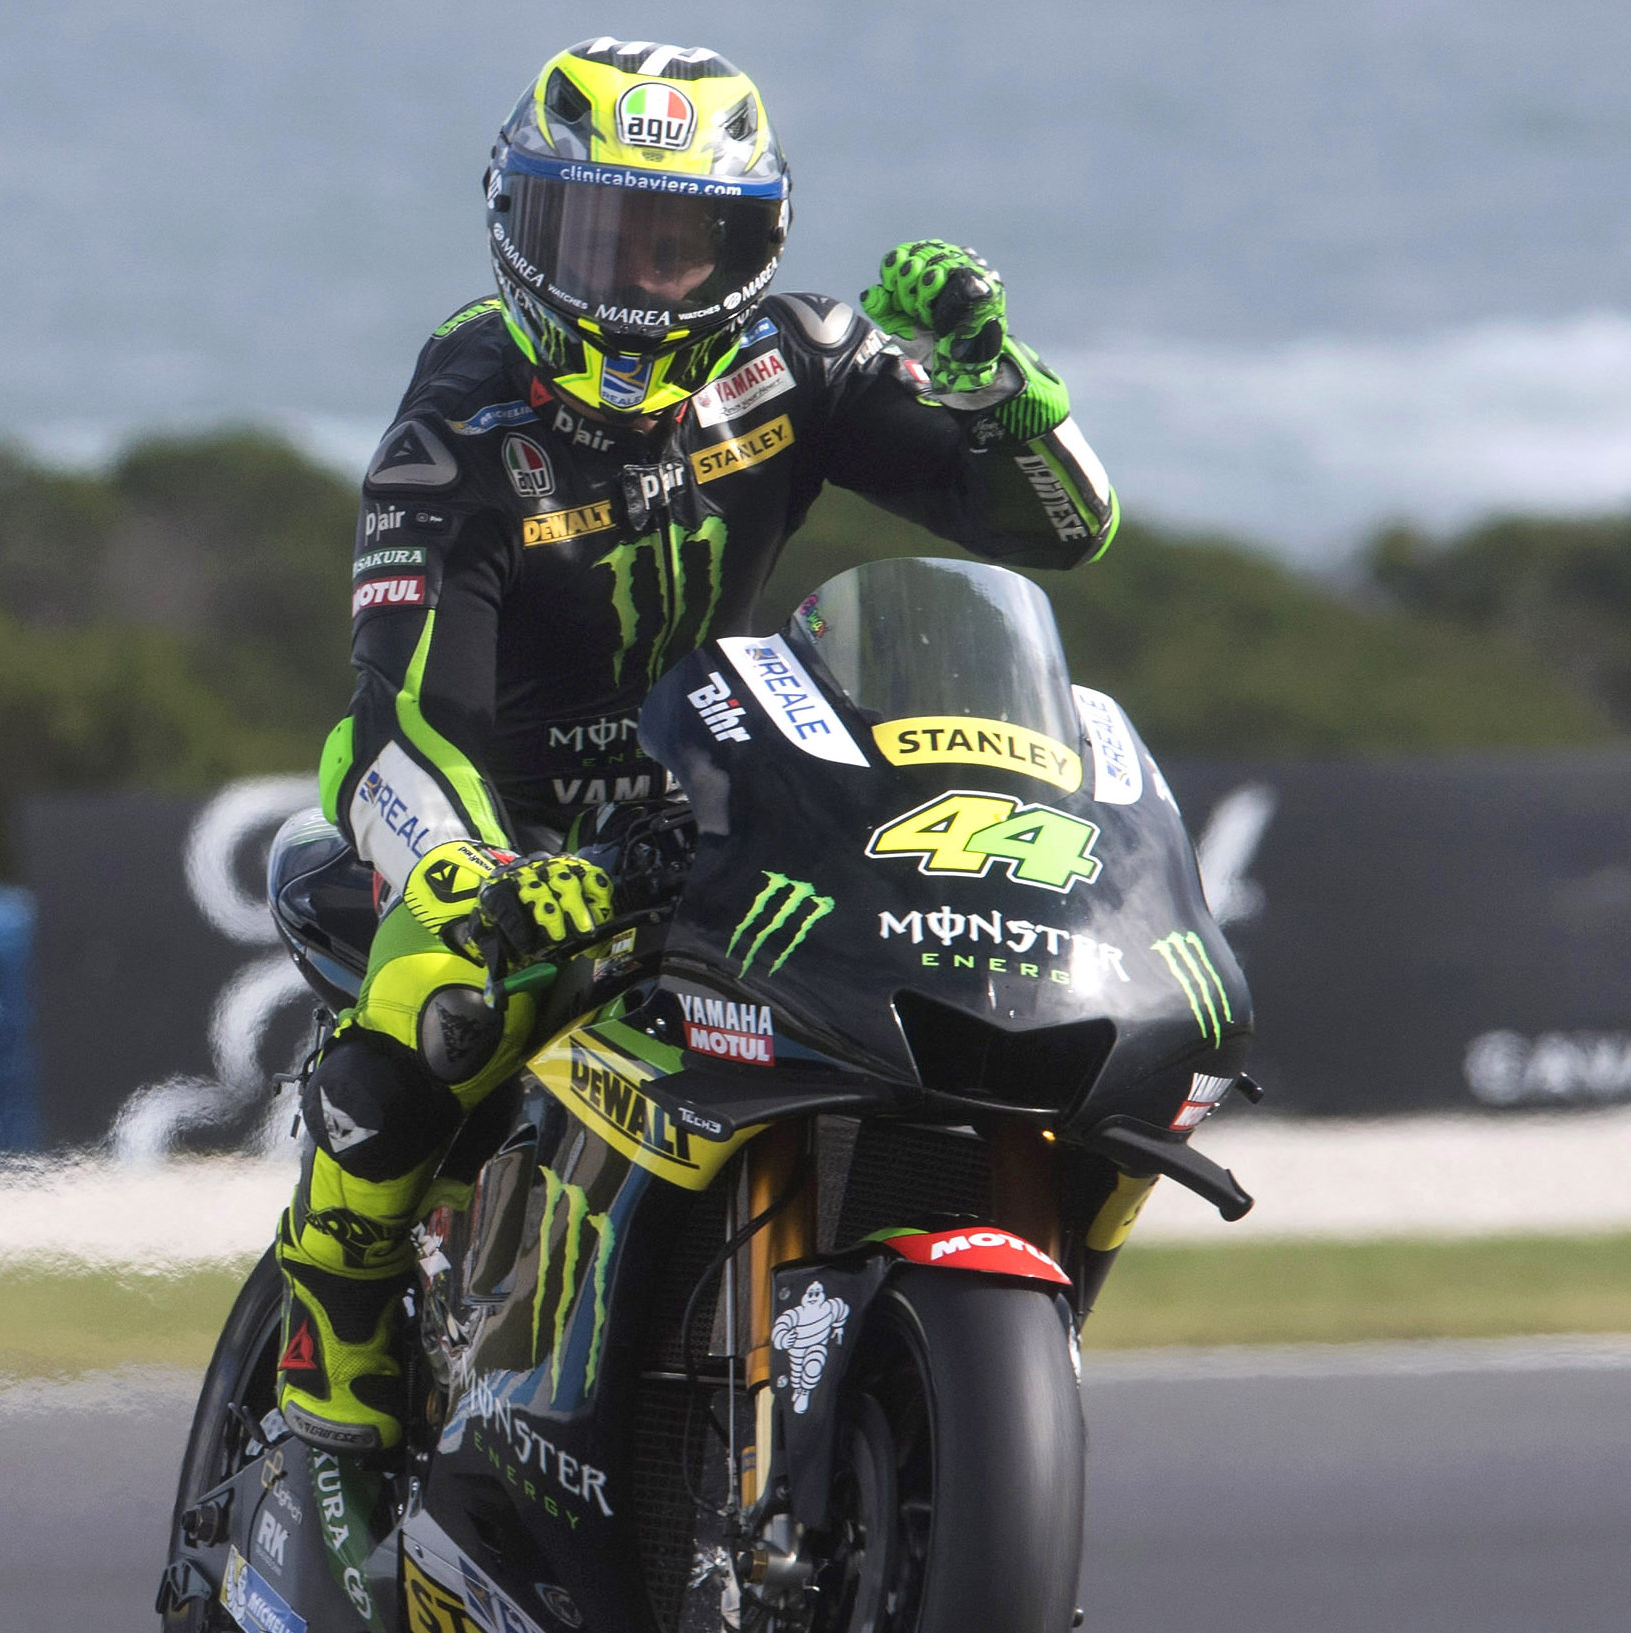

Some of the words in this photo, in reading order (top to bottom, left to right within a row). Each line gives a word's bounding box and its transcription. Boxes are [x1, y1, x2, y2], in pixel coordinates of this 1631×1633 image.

[628, 117, 684, 144] agv
[559, 165, 742, 197] clinicabaviera.com
[501, 238, 545, 287] MAREA
[547, 283, 588, 310] WATCHES
[594, 304, 670, 326] MAREA
[678, 305, 721, 321] WATCHES
[741, 256, 778, 301] MAREA
[715, 355, 785, 403] YAMAHA
[698, 425, 787, 474] STANLEY
[687, 671, 752, 743] Bihr
[758, 660, 832, 741] REALE
[581, 747, 649, 768] ENE
[898, 728, 1068, 776] STANLEY
[375, 784, 430, 859] REAL
[866, 790, 1103, 894] 44
[921, 953, 1071, 984] ENERG
[677, 994, 774, 1036] YAMAHA
[690, 1026, 770, 1062] MOTUL
[312, 1448, 350, 1551] KURA
[473, 1430, 580, 1530] ENERGY
[257, 1509, 290, 1567] RK
[247, 1591, 300, 1633] MICHEL
